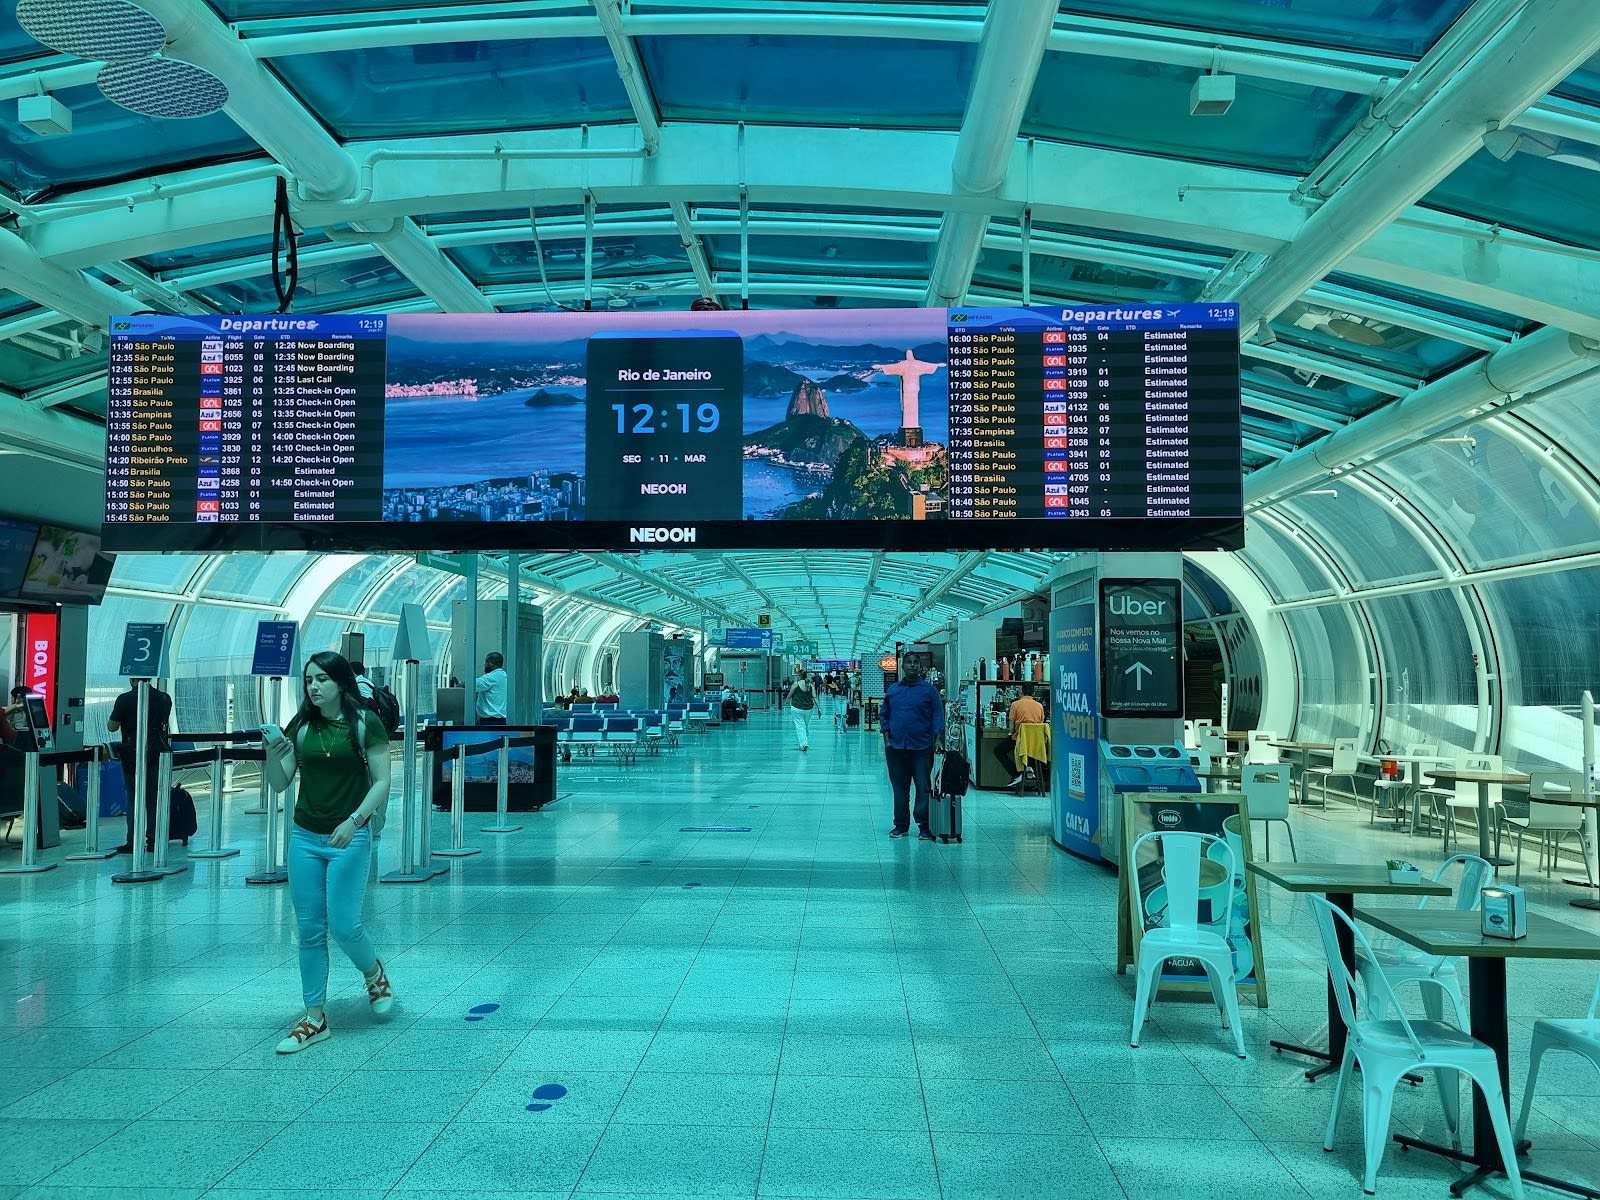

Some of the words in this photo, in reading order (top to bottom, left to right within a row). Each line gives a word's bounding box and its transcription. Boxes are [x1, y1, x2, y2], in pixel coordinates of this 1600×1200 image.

[1061, 308, 1162, 323] Departures
[1208, 309, 1234, 318] 12:19
[220, 318, 314, 331] Departures
[359, 320, 384, 329] 12:19
[618, 369, 639, 380] Rio
[643, 369, 660, 381] de
[662, 368, 712, 381] Janeiro
[132, 411, 172, 420] Campinas
[612, 403, 720, 434] 12:19
[974, 428, 1015, 436] Campinas
[622, 455, 641, 463] SEG
[684, 455, 706, 463] MAR
[641, 483, 687, 495] NEOOH
[630, 528, 696, 543] NEOOH
[1109, 596, 1166, 615] Uber
[134, 638, 151, 662] 3
[34, 640, 48, 677] BOA
[1060, 665, 1078, 690] Tem
[1062, 692, 1092, 715] CAIXA,
[1066, 812, 1089, 835] CAIXA
